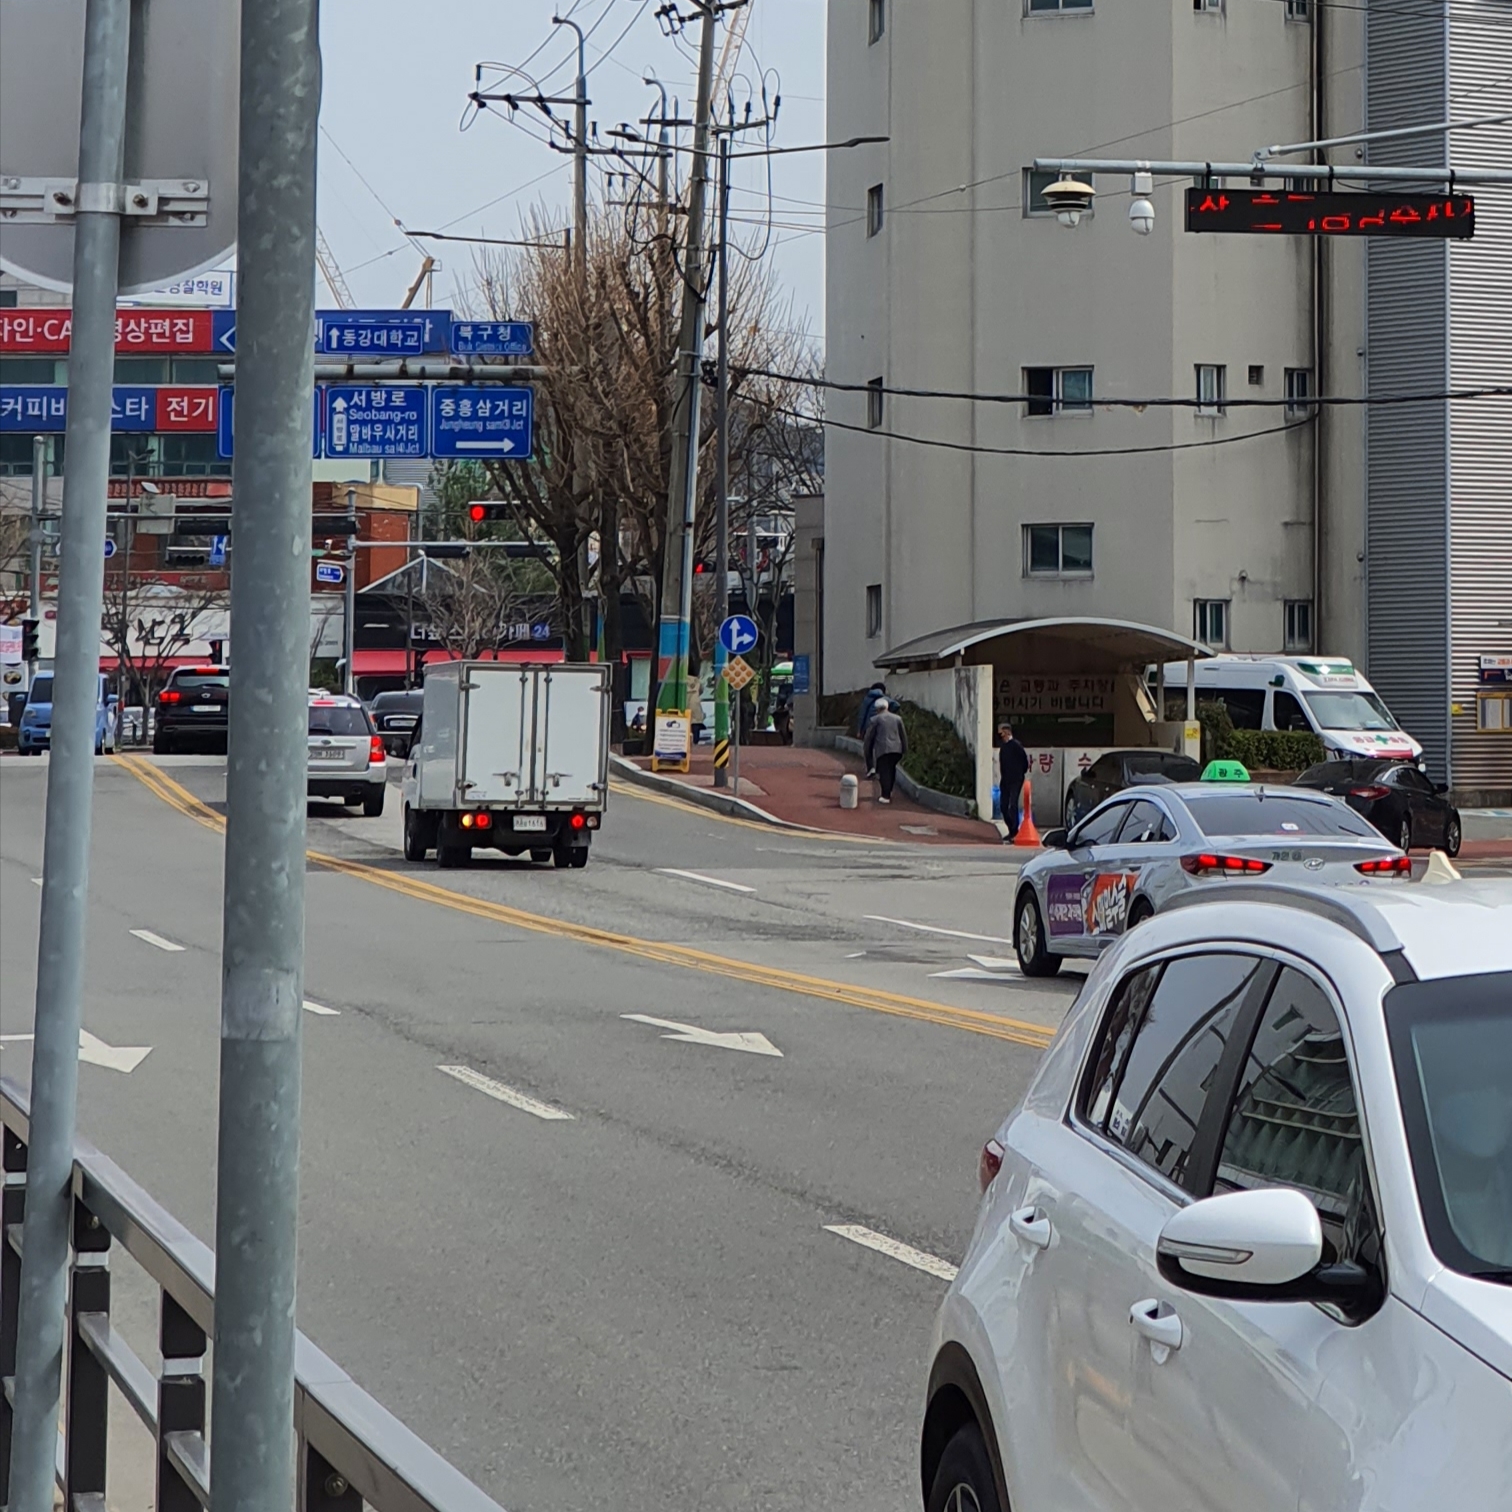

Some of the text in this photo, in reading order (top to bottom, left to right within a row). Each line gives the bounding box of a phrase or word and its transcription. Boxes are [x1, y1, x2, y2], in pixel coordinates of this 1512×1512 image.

[342, 329, 419, 347] 동강대학교
[459, 325, 512, 341] 북구청
[350, 390, 407, 407] 서방로
[166, 396, 214, 422] 전기
[349, 409, 417, 422] Seobang-ro
[439, 399, 528, 418] 중흥삼거리
[350, 424, 419, 442] 말바우사거리
